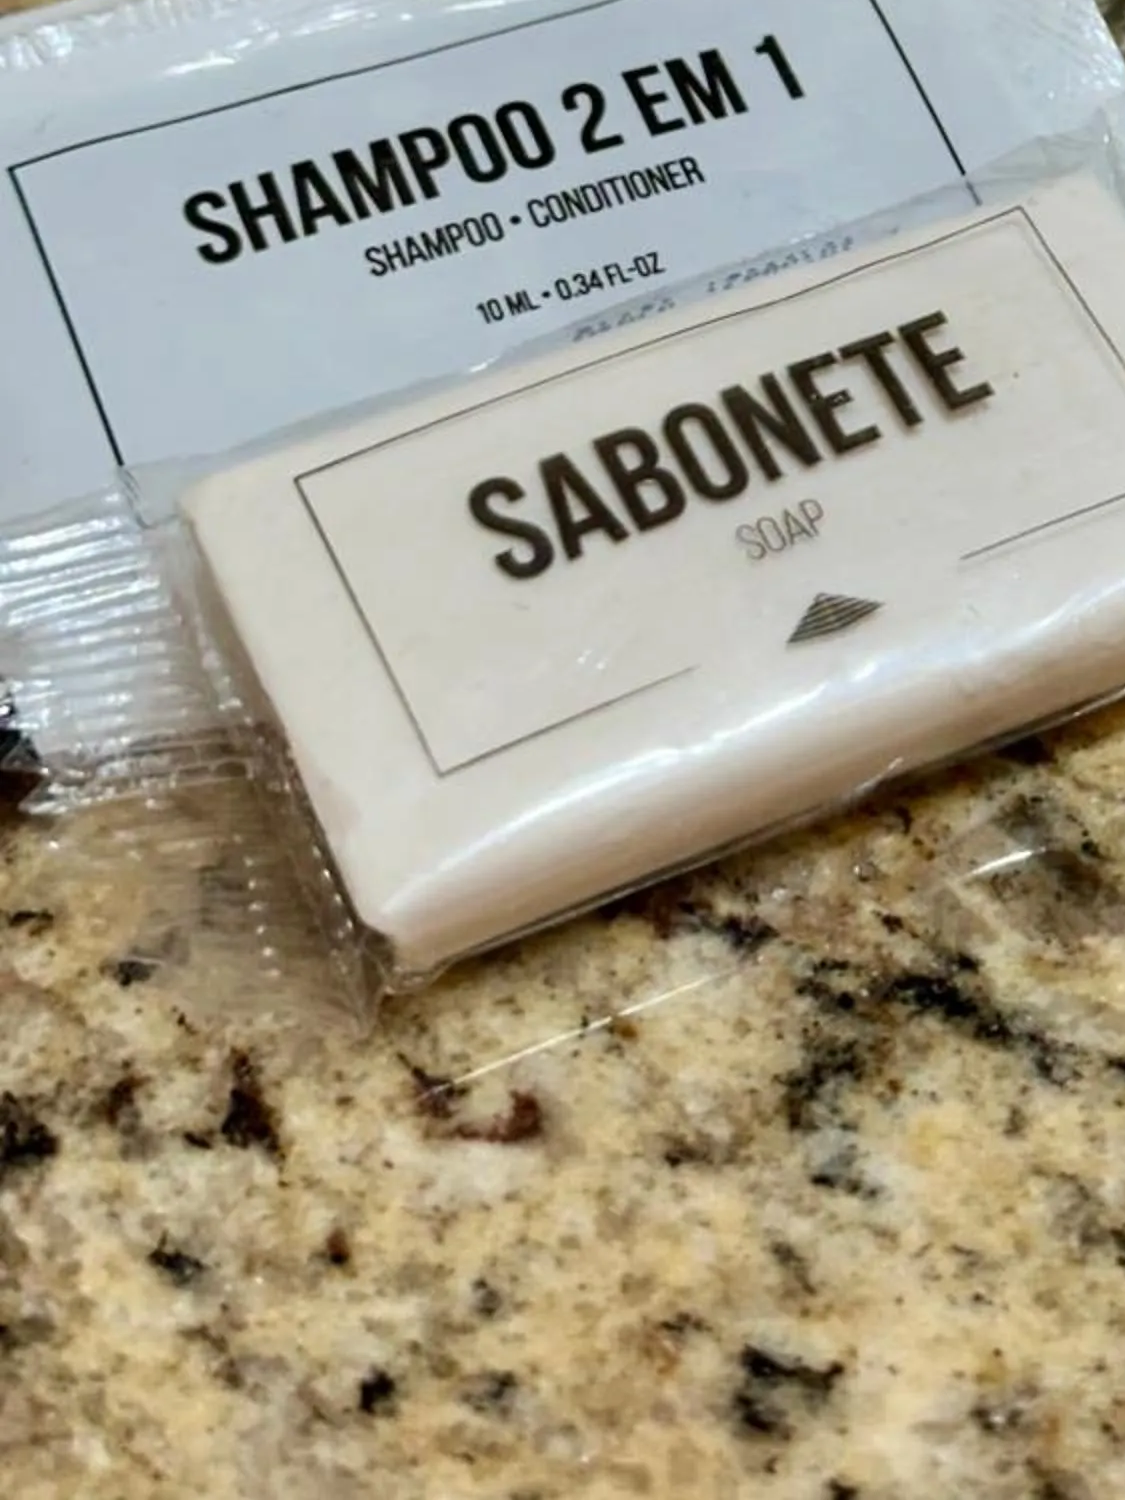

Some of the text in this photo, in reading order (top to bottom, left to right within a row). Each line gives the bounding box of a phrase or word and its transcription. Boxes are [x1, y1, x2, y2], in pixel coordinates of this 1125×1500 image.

[183, 34, 805, 265] SHAMPOO 2 EM 1
[364, 156, 706, 277] SHAMPOO CONDITIONER
[475, 251, 667, 325] 10 ML 0.34 FL-OZ
[468, 310, 995, 581] SABONETE
[735, 499, 825, 561] SOAP
